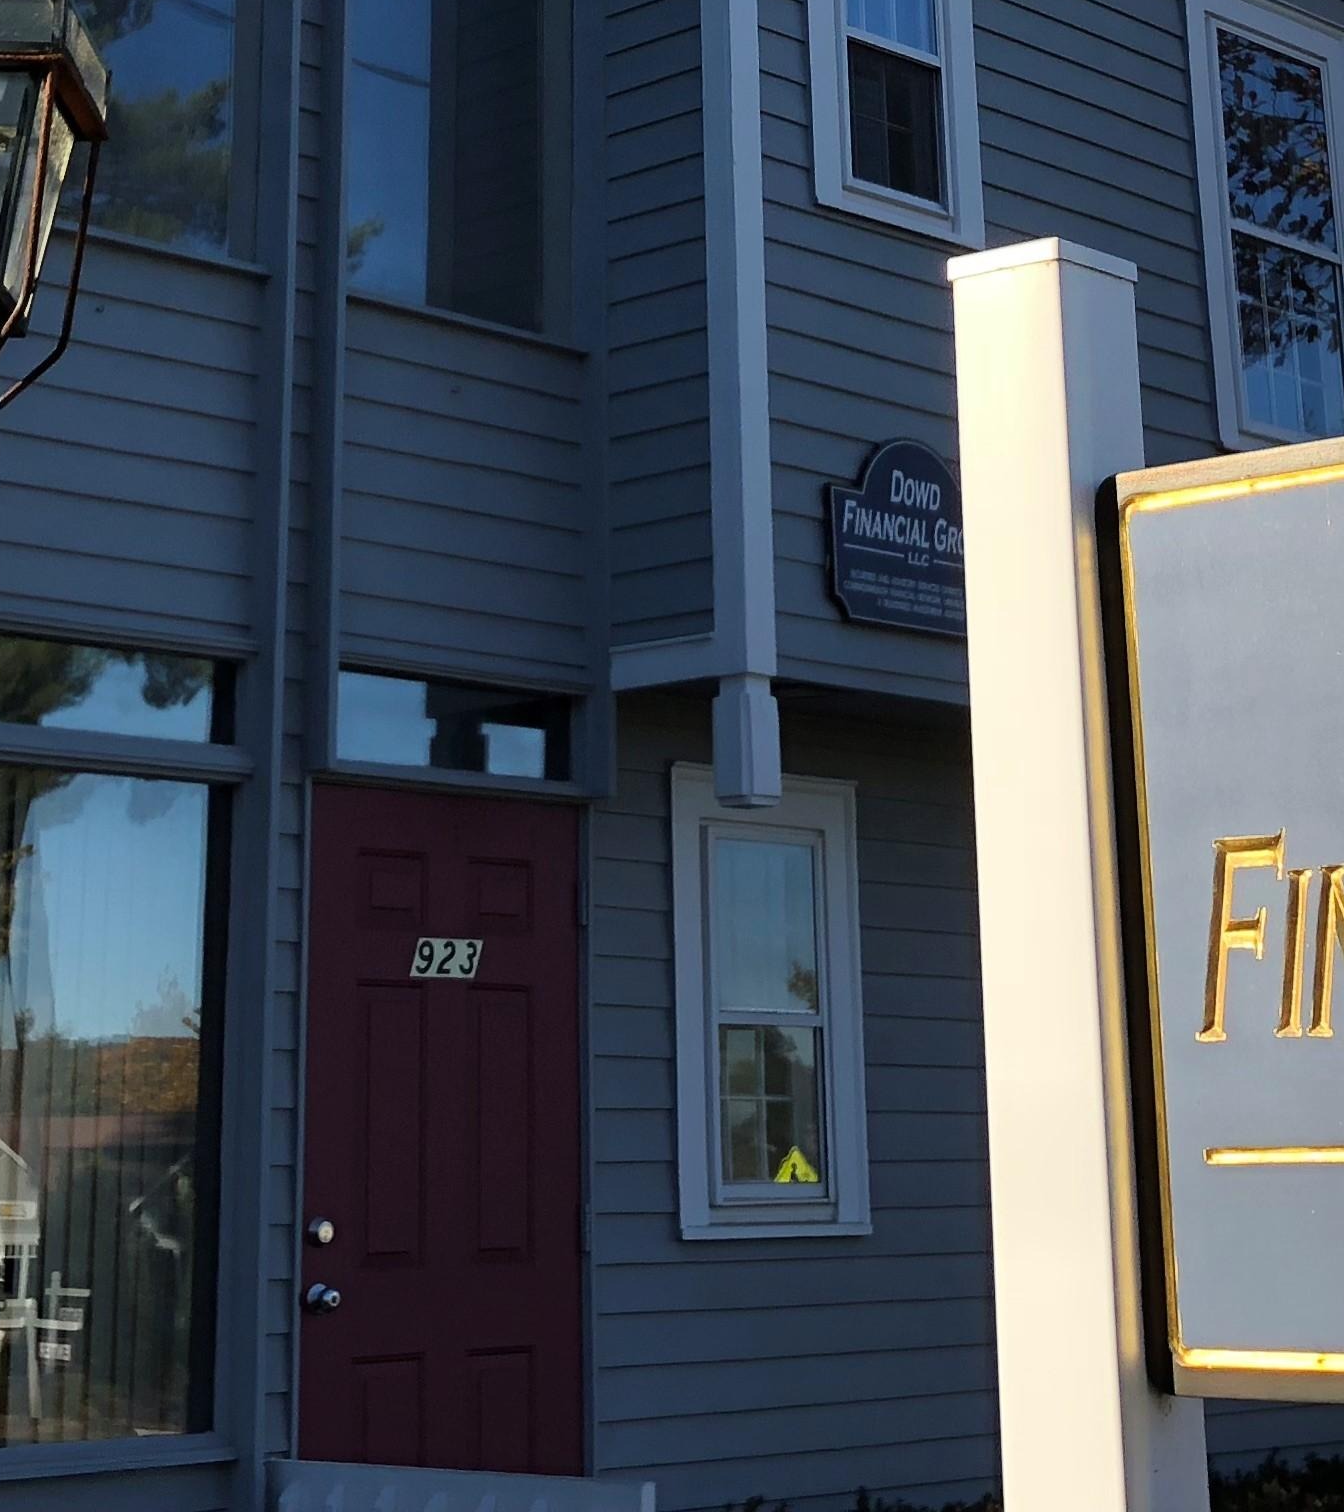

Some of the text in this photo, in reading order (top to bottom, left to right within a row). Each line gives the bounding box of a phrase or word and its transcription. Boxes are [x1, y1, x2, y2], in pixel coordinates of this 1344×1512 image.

[890, 469, 940, 510] DOWD
[842, 499, 930, 548] FINANCIAL
[908, 551, 930, 566] LLC
[416, 940, 477, 974] 923
